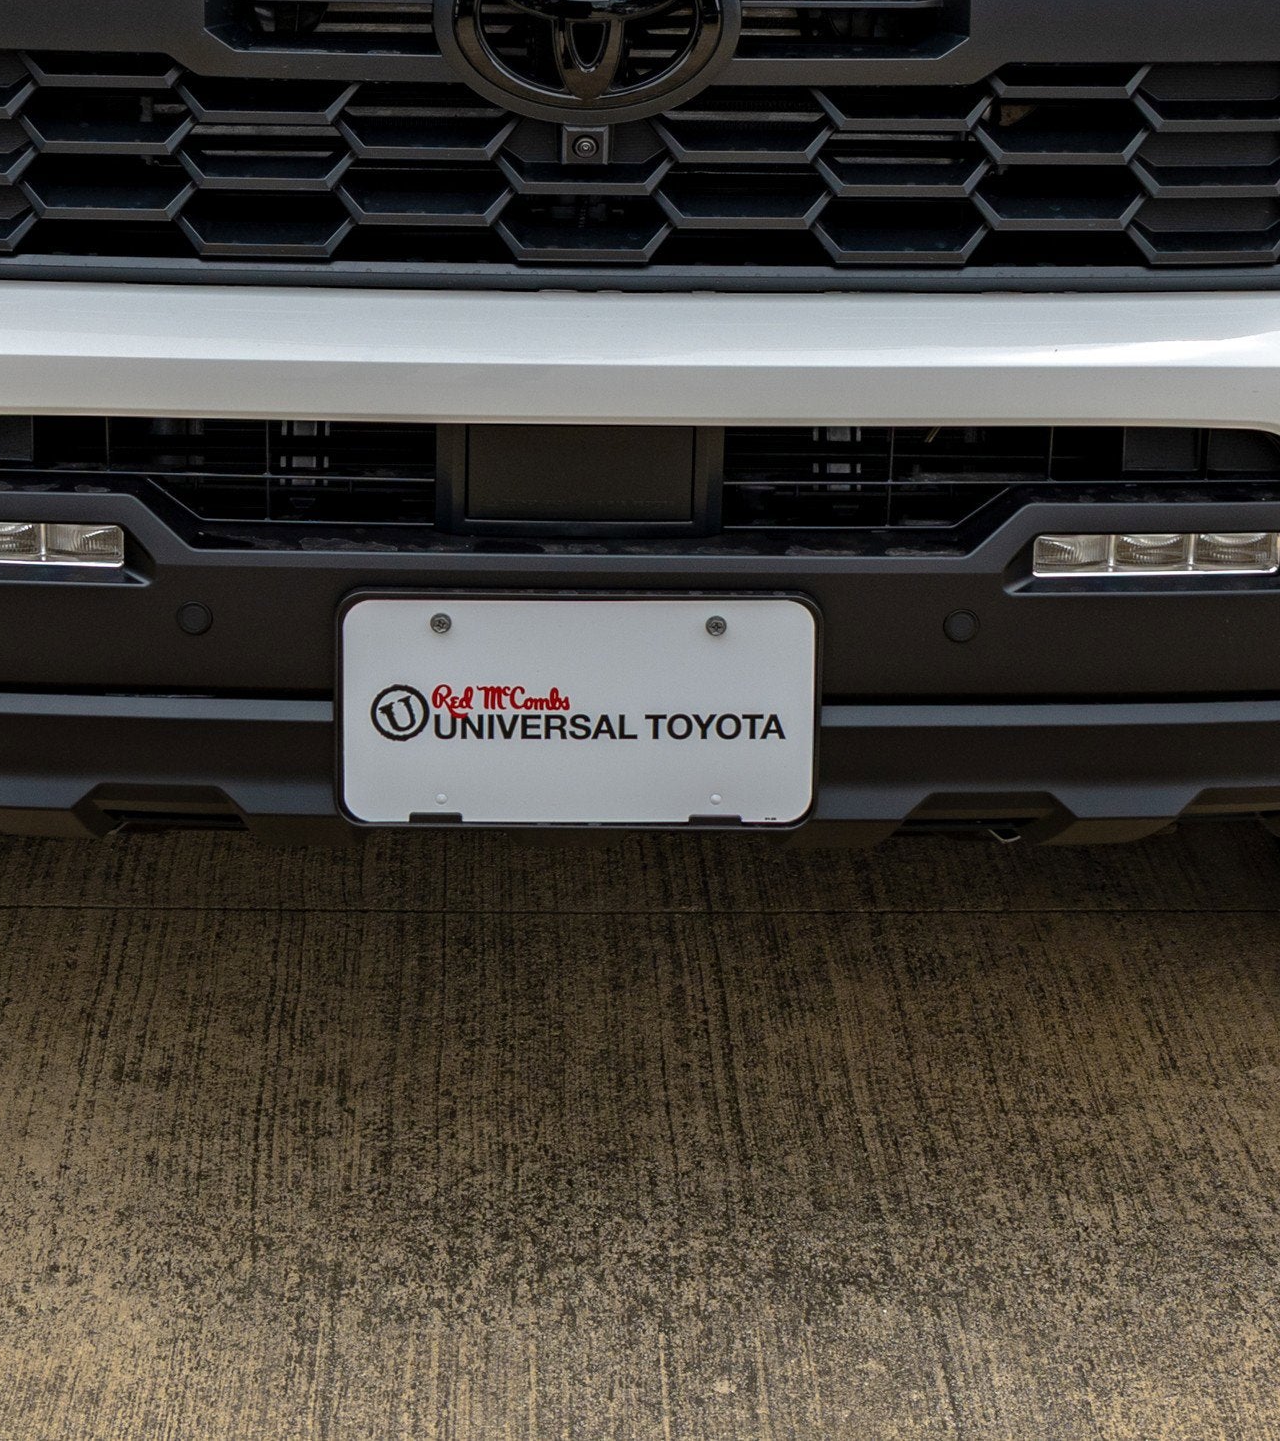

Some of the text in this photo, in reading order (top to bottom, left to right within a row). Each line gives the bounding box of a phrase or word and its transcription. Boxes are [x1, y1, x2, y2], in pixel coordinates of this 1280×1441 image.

[432, 684, 571, 719] Red McCombs
[434, 713, 786, 740] UNIVERSAL TOYOTA
